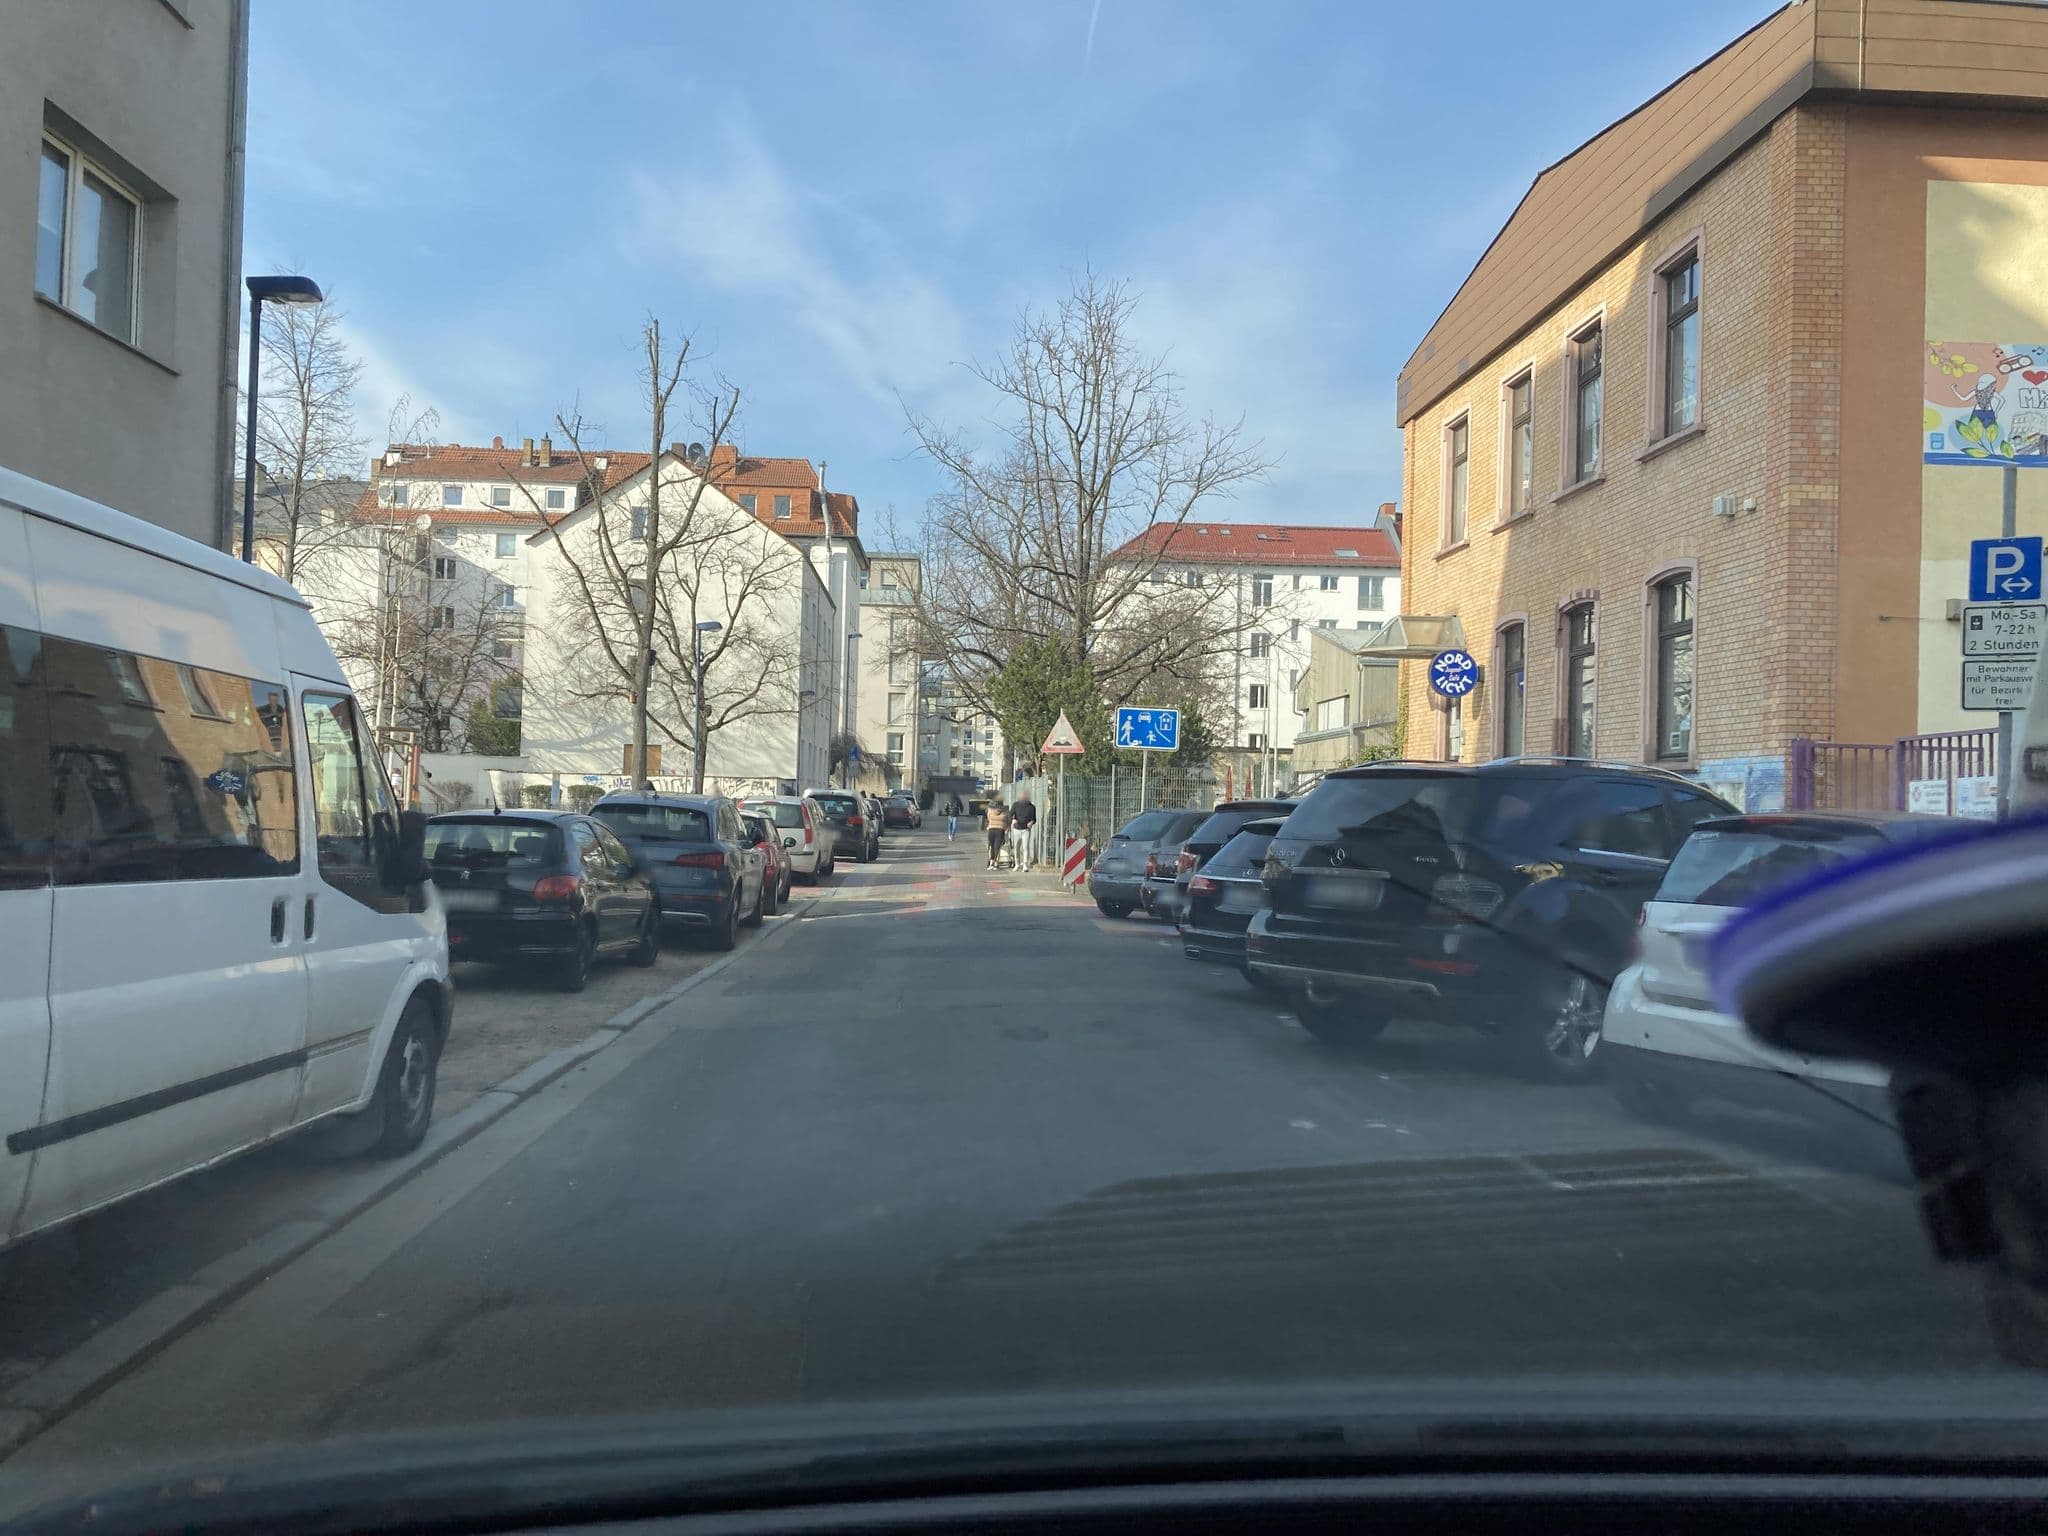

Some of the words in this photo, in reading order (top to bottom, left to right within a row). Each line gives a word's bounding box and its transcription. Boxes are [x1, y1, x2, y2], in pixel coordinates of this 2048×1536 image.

[1986, 546, 2025, 594] P
[1995, 624, 2025, 635] 7-22
[1969, 640, 1977, 651] 2
[1984, 639, 2039, 650] Stunden
[1434, 653, 1472, 673] NORD
[1978, 665, 2028, 674] Bewohner
[1435, 675, 1473, 694] LICHT
[1966, 675, 1981, 683] mit
[1971, 686, 1985, 694] für
